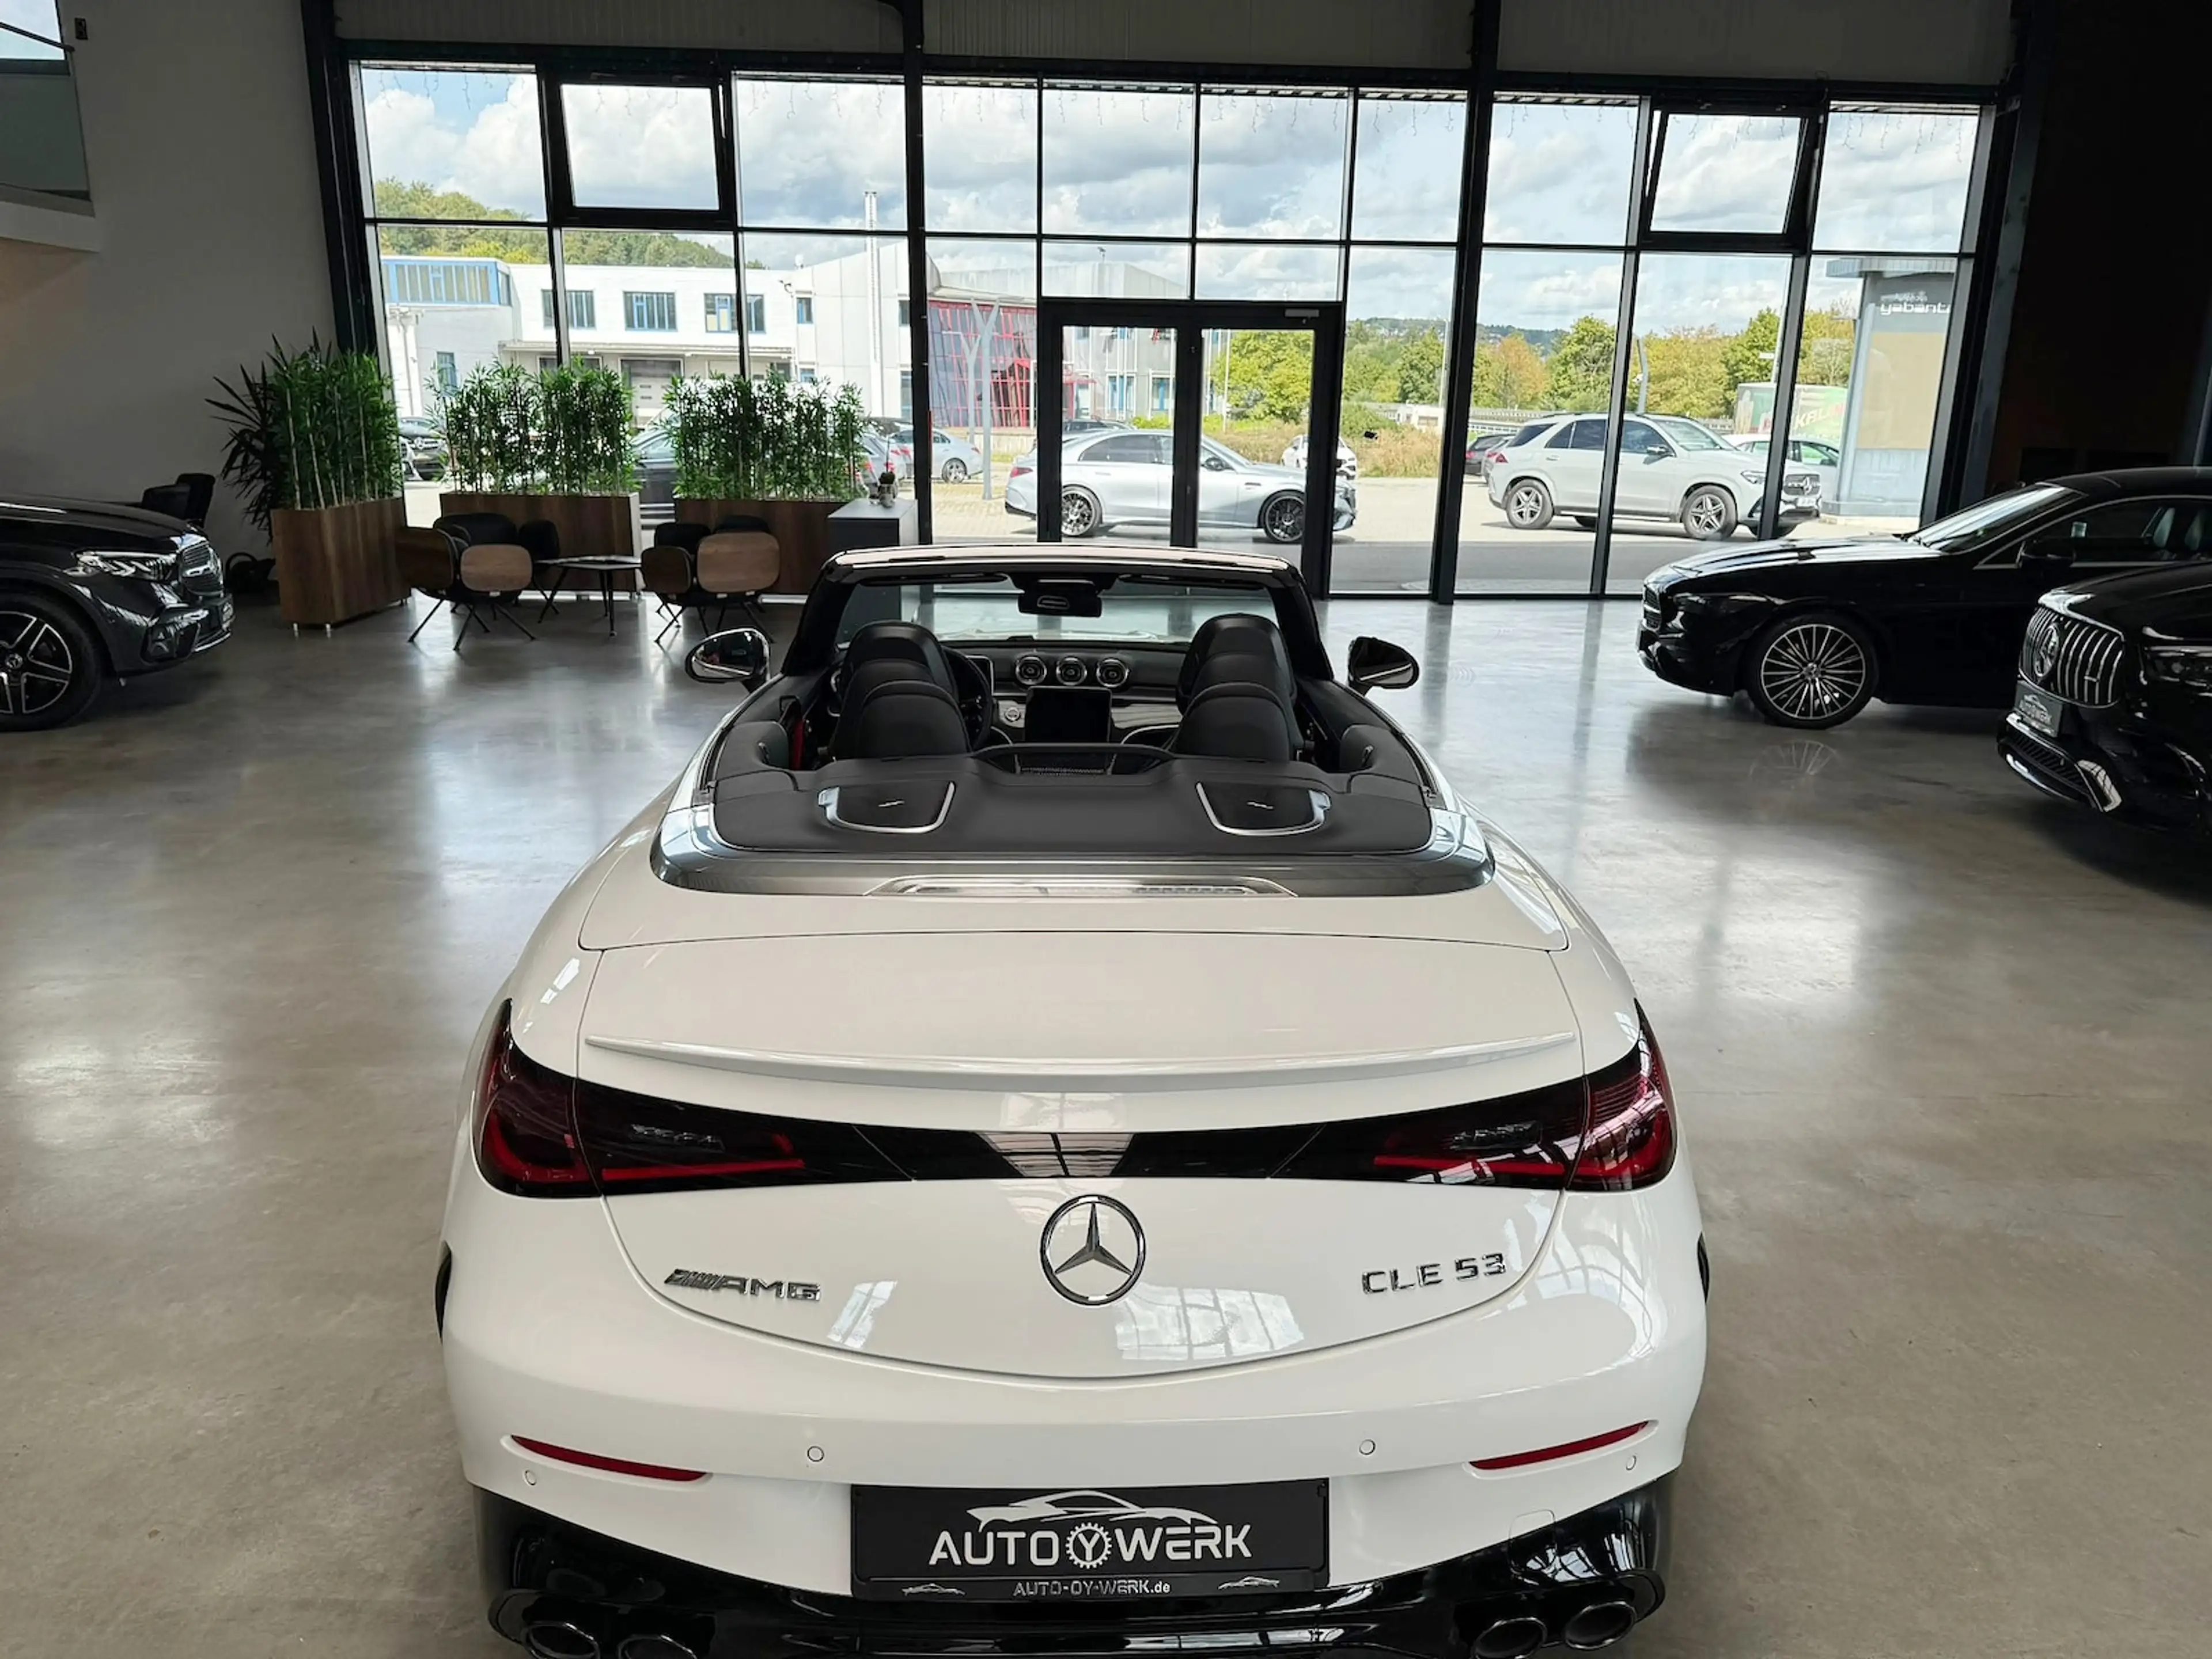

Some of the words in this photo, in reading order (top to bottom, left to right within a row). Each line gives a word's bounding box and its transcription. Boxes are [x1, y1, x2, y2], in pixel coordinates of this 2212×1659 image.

[712, 1274, 821, 1301] AMG
[1361, 1263, 1444, 1294] CLE
[1455, 1252, 1506, 1281] 53
